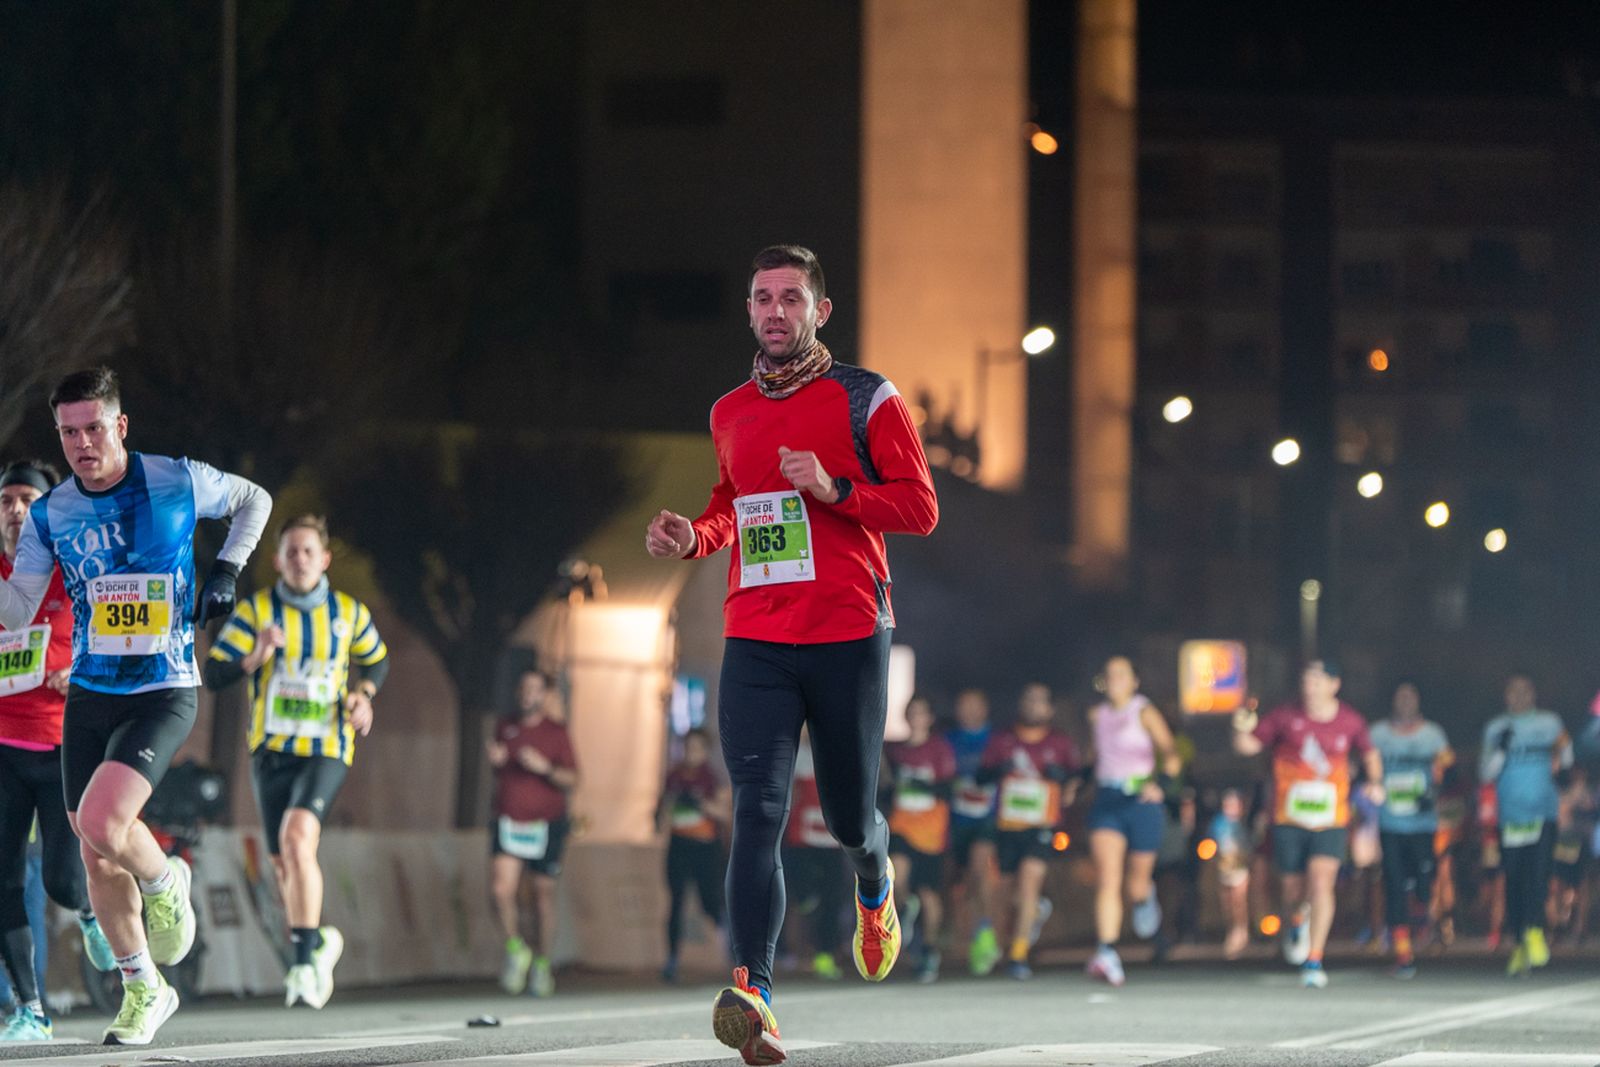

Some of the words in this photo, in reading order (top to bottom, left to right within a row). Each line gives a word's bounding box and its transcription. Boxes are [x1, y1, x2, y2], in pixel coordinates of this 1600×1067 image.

[762, 502, 774, 513] DE
[747, 525, 786, 554] 363
[129, 583, 139, 592] DE
[110, 591, 140, 602] ANTÓN
[106, 603, 150, 628] 394
